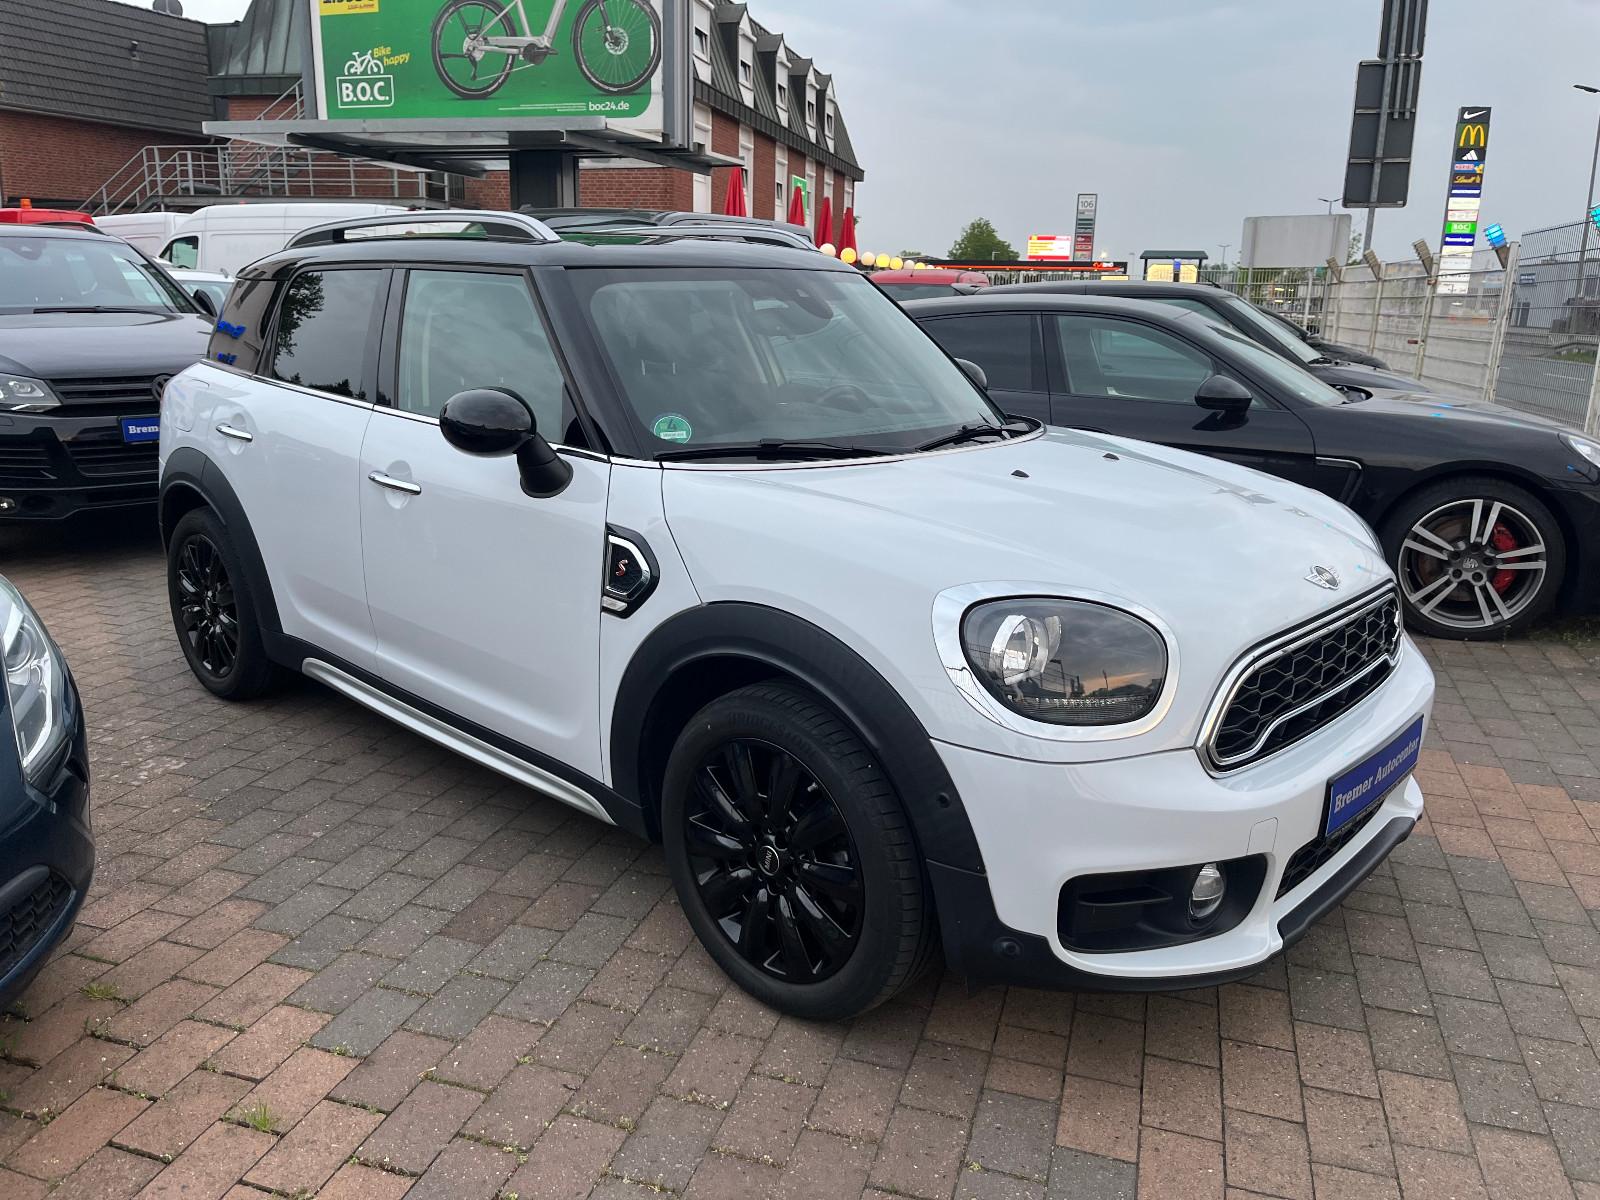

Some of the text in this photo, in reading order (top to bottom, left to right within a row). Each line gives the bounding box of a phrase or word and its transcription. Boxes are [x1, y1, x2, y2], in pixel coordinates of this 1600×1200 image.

[373, 46, 391, 58] Bike
[383, 52, 410, 66] happy
[341, 81, 389, 102] B.O.C.
[588, 100, 630, 111] boc24.de
[1080, 200, 1094, 208] 106
[128, 424, 160, 434] Brem
[1333, 736, 1420, 814] Bremer Autocenter
[764, 850, 773, 870] MINI
